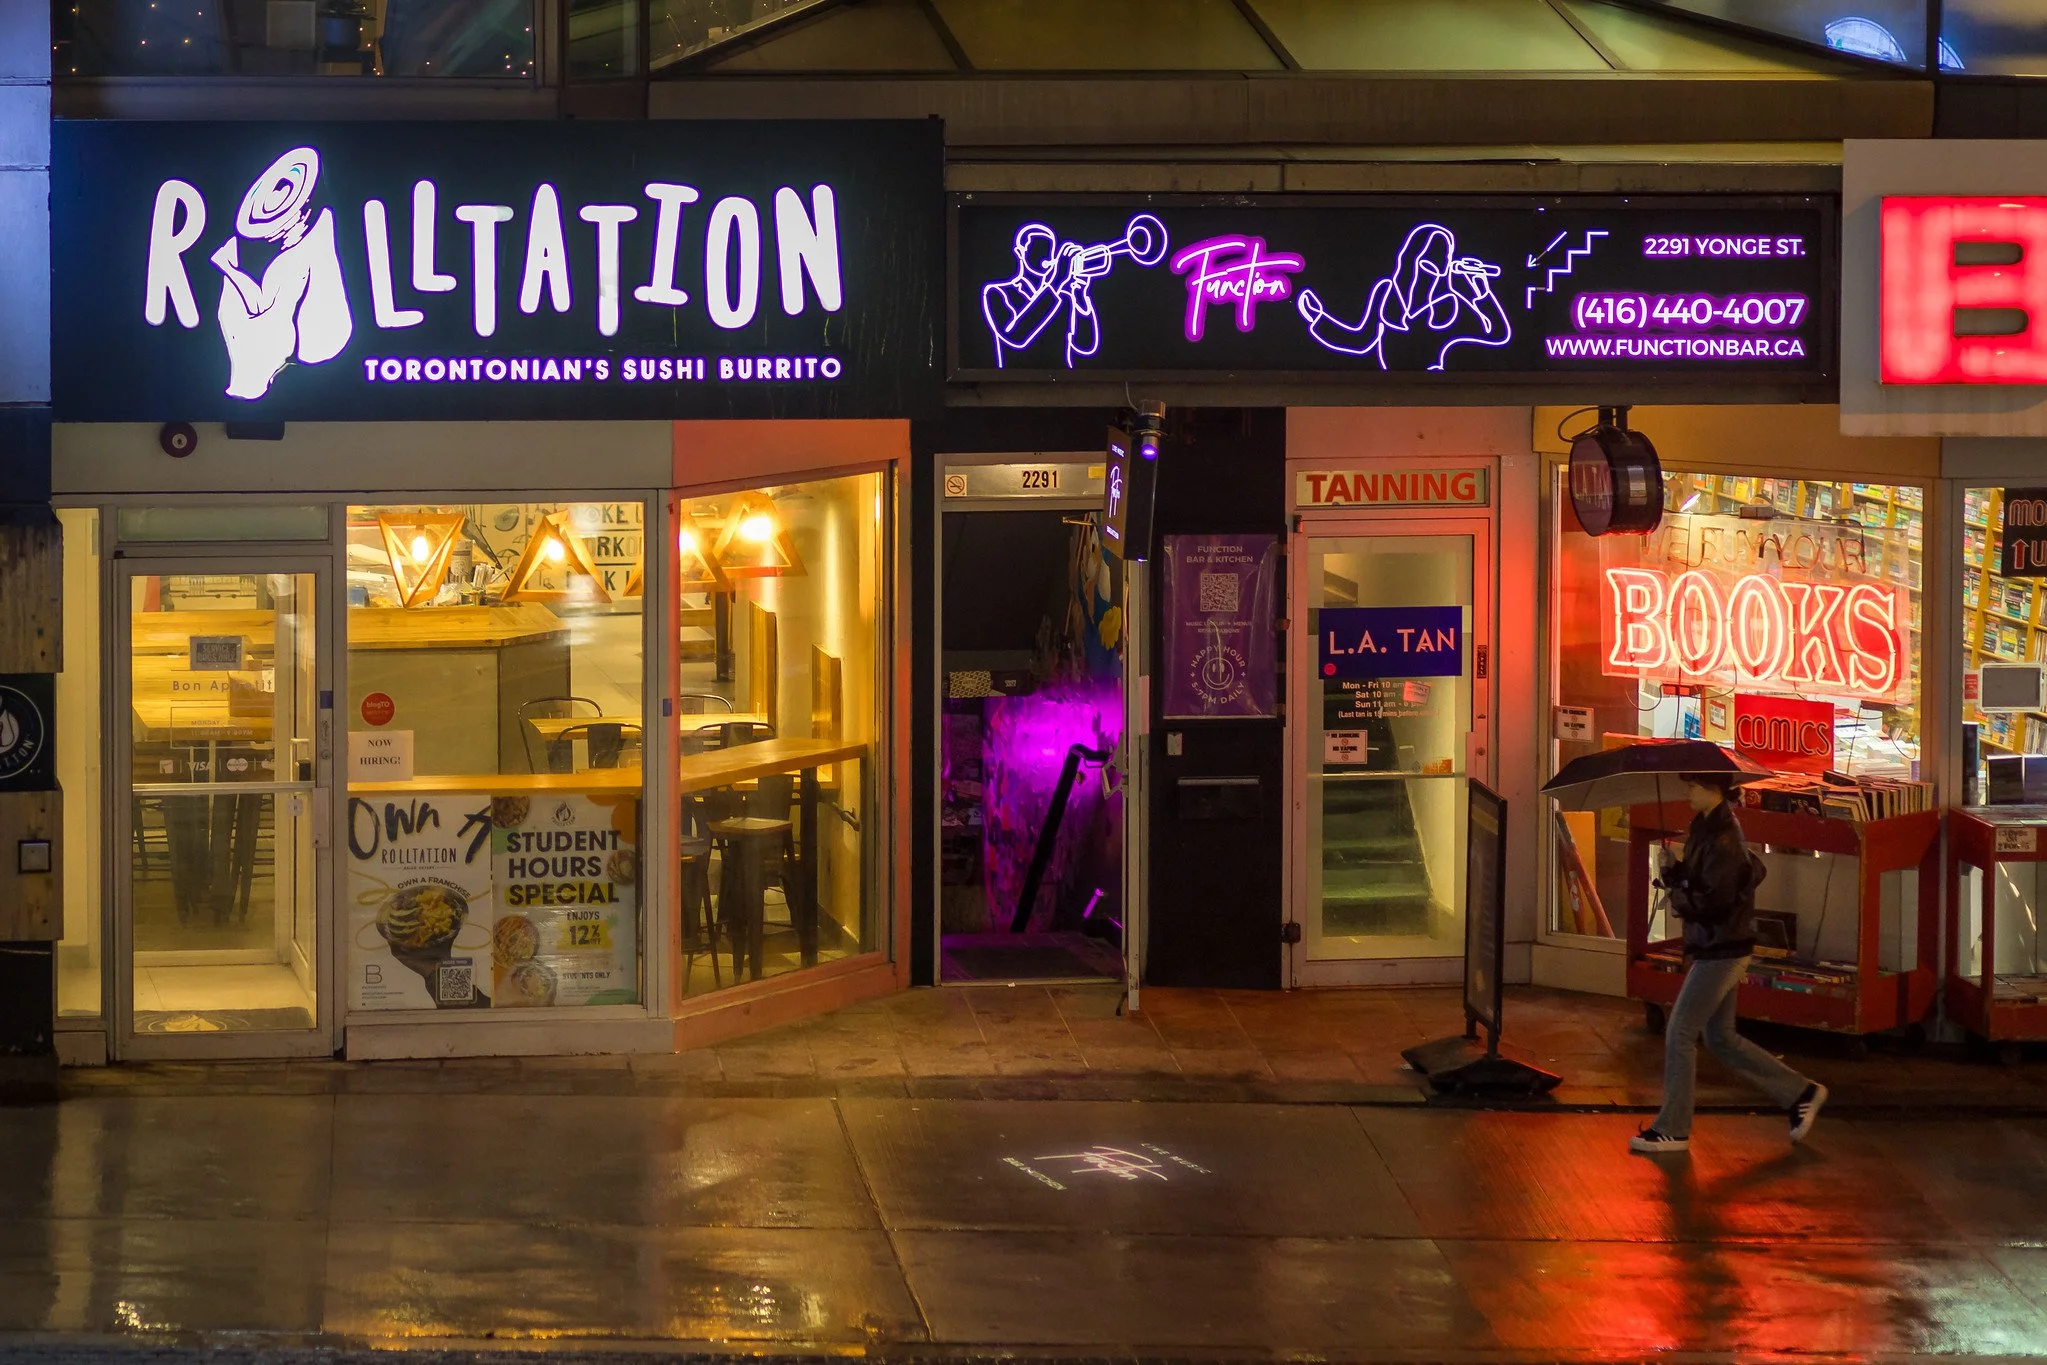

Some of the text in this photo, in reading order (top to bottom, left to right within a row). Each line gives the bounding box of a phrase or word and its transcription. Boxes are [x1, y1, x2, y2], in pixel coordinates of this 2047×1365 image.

[1645, 238, 1806, 255] 2291 YONGE ST.
[1177, 241, 1301, 337] Function
[1546, 338, 1805, 356] WWW.FUNCTIONBAR.CA
[364, 357, 841, 381] TORONTONIAN'S SUSHI BURRITO
[1022, 470, 1058, 489] 2291
[1305, 472, 1476, 503] TANNING
[1197, 545, 1243, 553] FUNCTION
[1186, 555, 1205, 563] BAR
[1215, 555, 1254, 563] KITCHEN
[1605, 568, 1898, 693] BOOKS
[1329, 627, 1455, 655] L.A. TAN
[1190, 644, 1246, 668] HAPPY HOUR
[172, 680, 202, 691] Bon
[1191, 681, 1245, 704] 5-7PM DAILY
[1342, 681, 1360, 689] Mon
[1368, 681, 1379, 689] Fri
[1381, 681, 1391, 689] 10
[1372, 690, 1382, 698] 10
[1355, 700, 1371, 708] Sun
[368, 739, 393, 747] NOW
[1735, 714, 1832, 757] COMICS
[360, 756, 401, 765] HIRING!
[506, 830, 622, 853] STUDENT
[381, 847, 457, 864] ROLLTATION
[508, 856, 602, 879] HOURS
[397, 877, 419, 890] OWN
[428, 876, 471, 899] FRANCHISE
[509, 882, 620, 906] SPECIAL
[567, 910, 600, 920] ENJOYS
